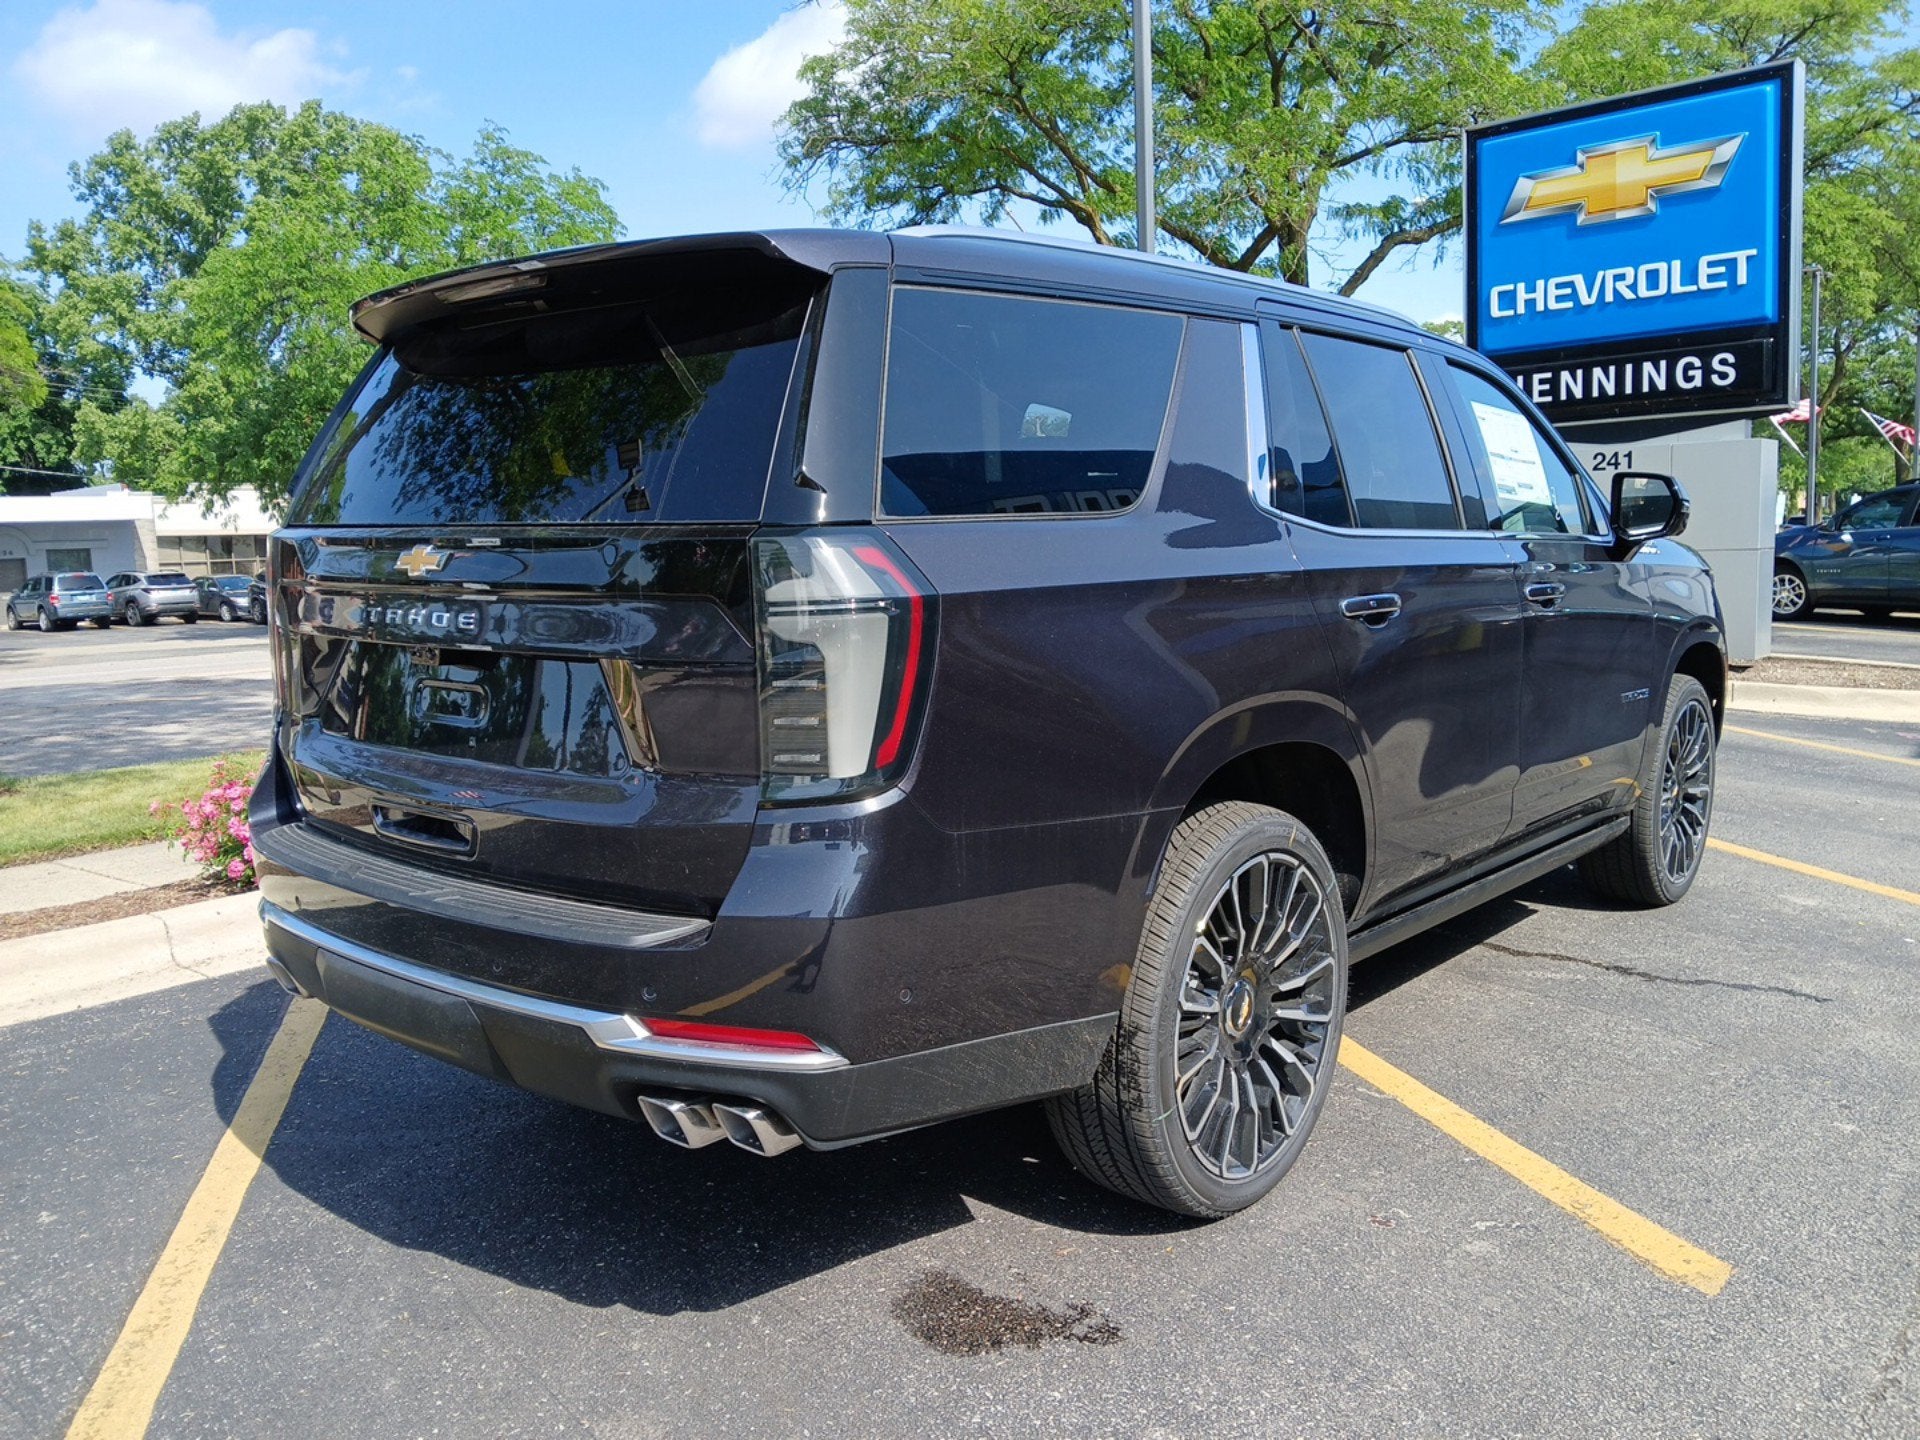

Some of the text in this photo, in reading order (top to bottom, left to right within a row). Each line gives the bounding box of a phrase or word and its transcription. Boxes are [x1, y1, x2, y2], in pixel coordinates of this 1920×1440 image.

[1490, 249, 1757, 318] CHEVROLET
[1516, 353, 1736, 403] ENNINGS
[1592, 450, 1633, 471] 241
[366, 606, 476, 629] TAHOE
